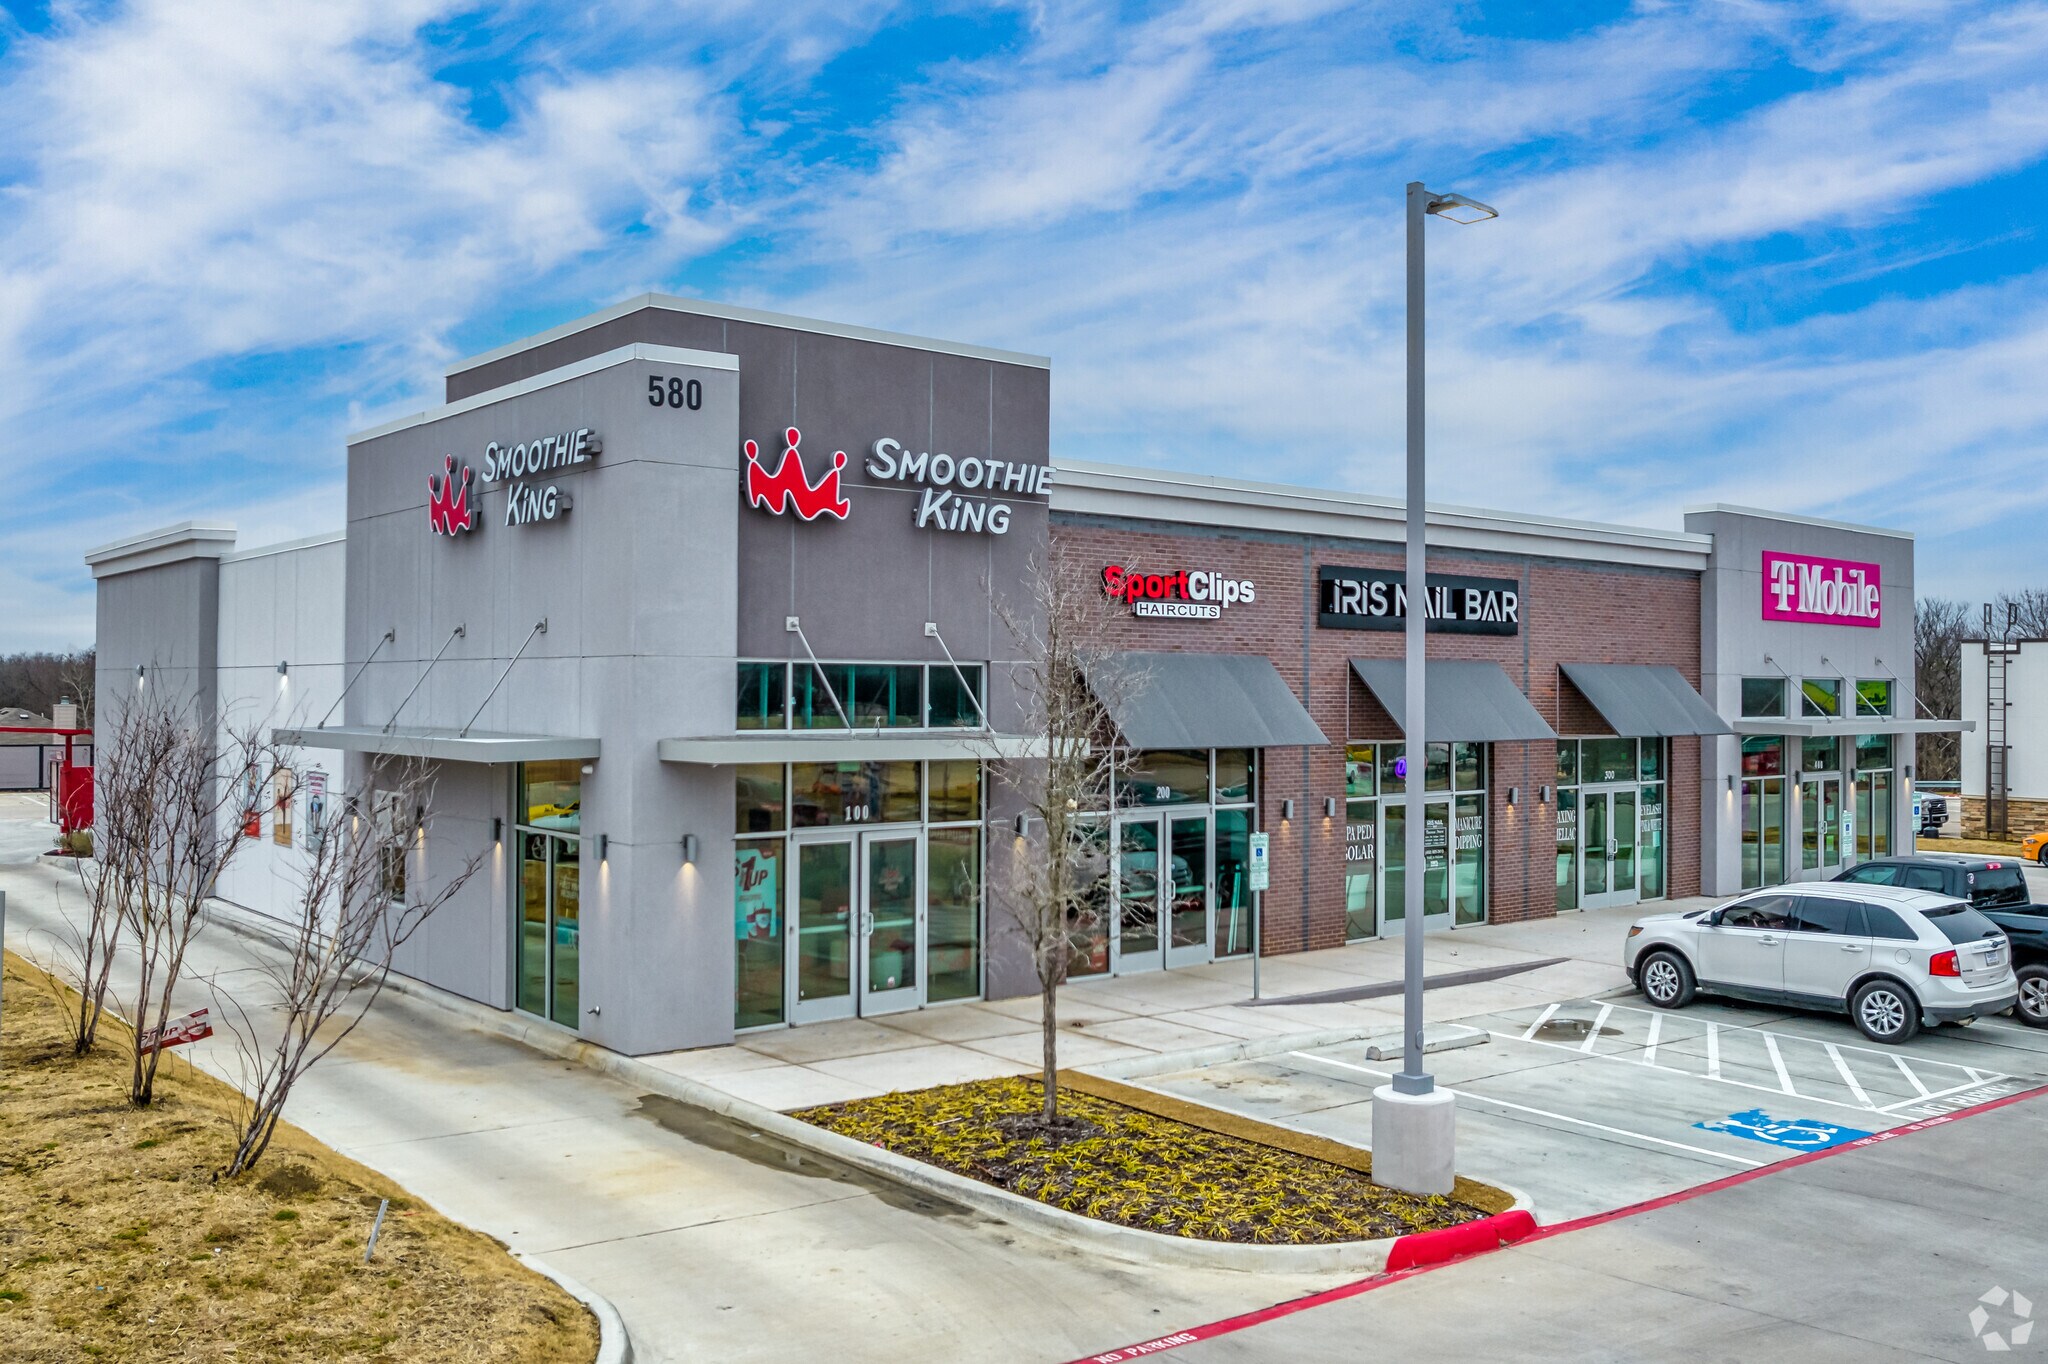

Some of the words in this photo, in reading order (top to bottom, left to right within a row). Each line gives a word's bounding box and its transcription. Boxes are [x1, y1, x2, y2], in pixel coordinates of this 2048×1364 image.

[648, 374, 702, 411] 580
[481, 428, 589, 483] SMOOTHIE
[867, 437, 1057, 495] SMOOTHIE
[1334, 579, 1388, 617] IRIS
[1465, 588, 1519, 623] BAR
[1138, 603, 1218, 618] HAIRCUTS
[1604, 770, 1615, 780] 300
[1156, 786, 1171, 799] 200
[845, 804, 870, 822] 100
[1556, 810, 1576, 824] AXING
[1455, 816, 1482, 831] MANICURE
[1346, 825, 1356, 841] PA
[1357, 824, 1375, 840] PEDI
[1556, 827, 1577, 841] ELLAC
[1455, 834, 1482, 850] DIPPING
[1093, 1353, 1123, 1364] NO
[1124, 1332, 1198, 1356] PARKING
